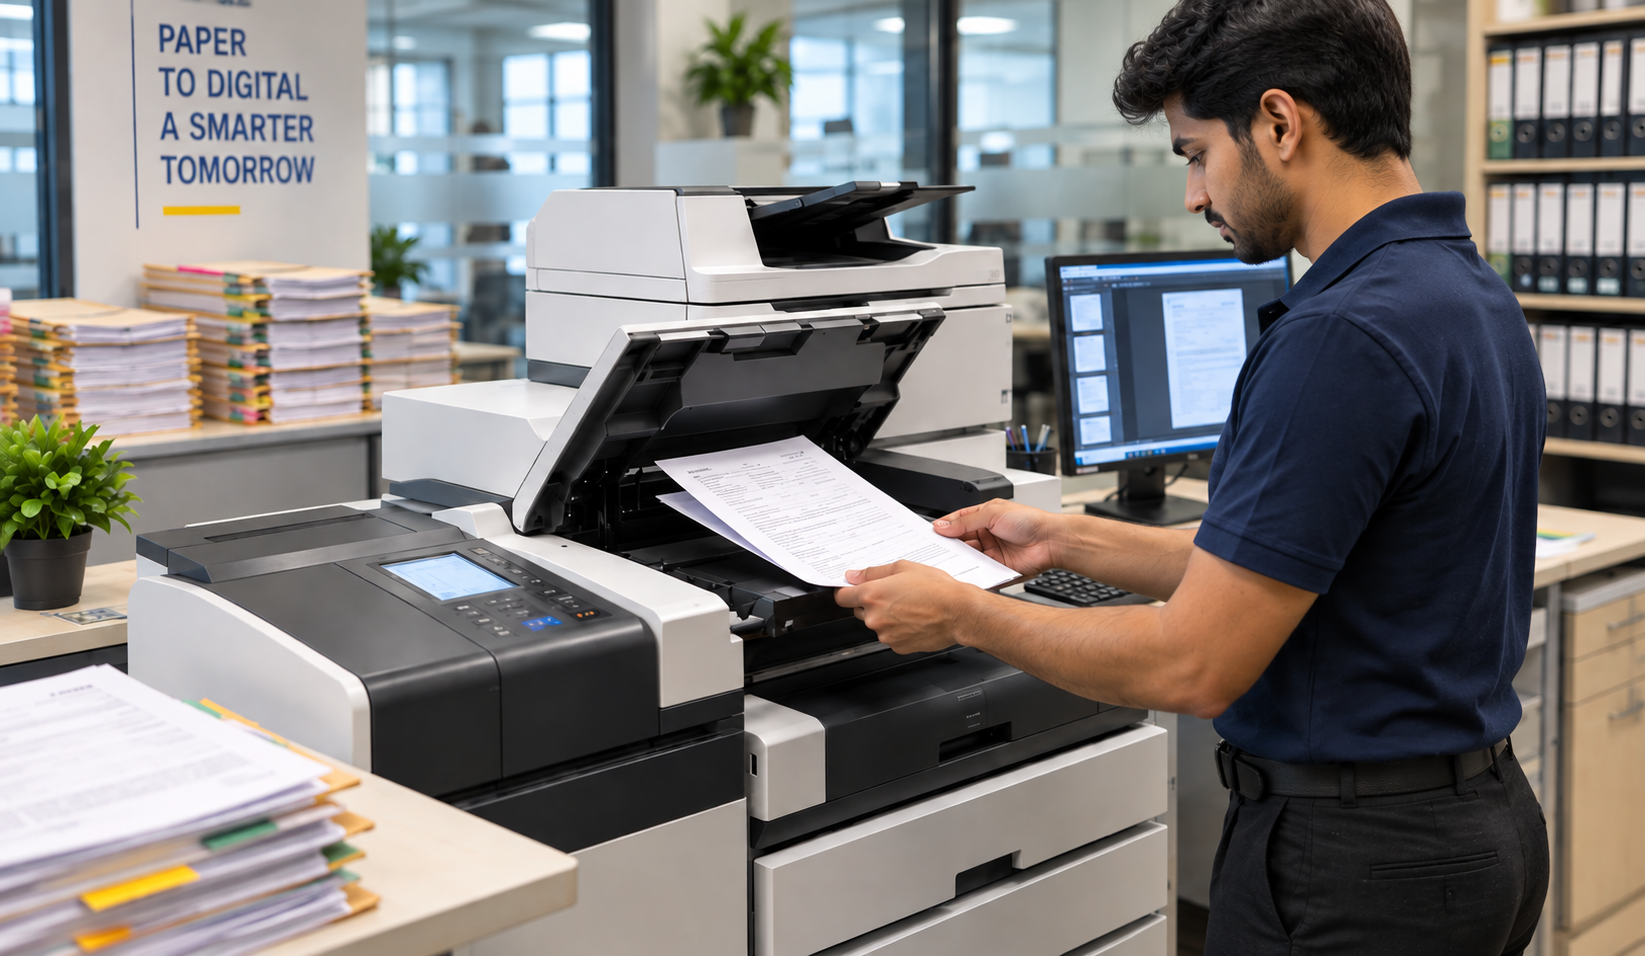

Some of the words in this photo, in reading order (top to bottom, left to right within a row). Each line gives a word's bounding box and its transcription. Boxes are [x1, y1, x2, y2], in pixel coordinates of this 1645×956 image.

[158, 24, 247, 57] PAPER
[158, 67, 196, 97] TO
[207, 69, 308, 101] DIGITAL
[160, 111, 179, 141] A
[190, 112, 314, 142] SMARTER
[160, 155, 315, 184] TOMORROW
